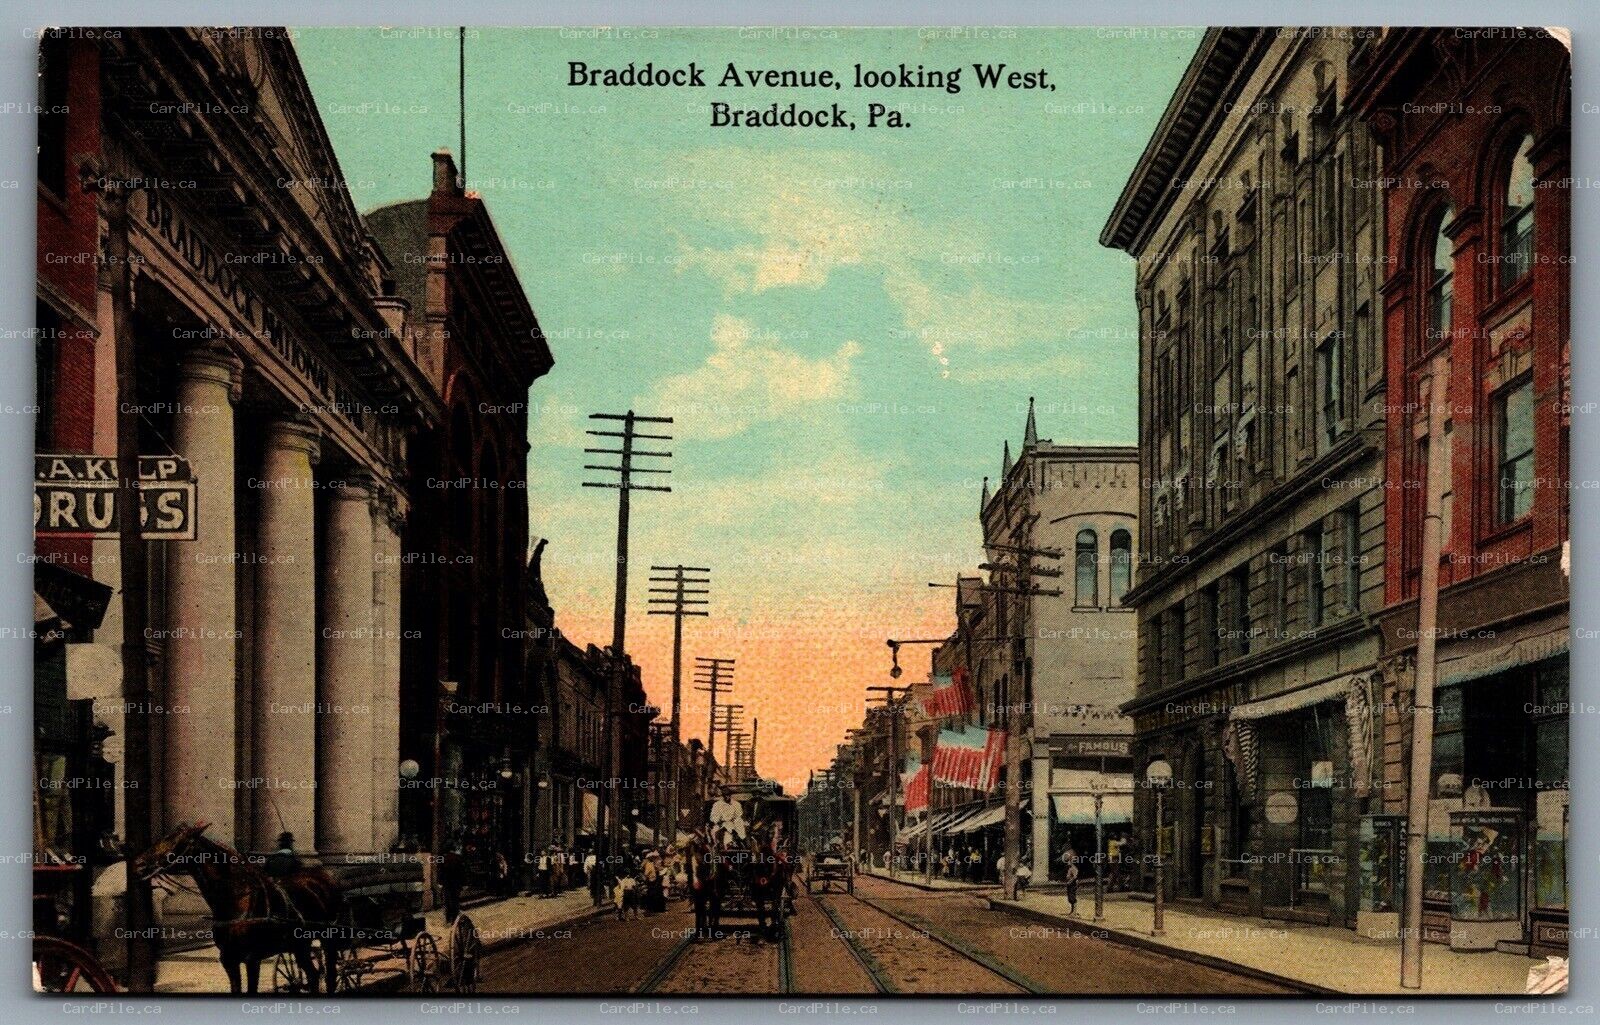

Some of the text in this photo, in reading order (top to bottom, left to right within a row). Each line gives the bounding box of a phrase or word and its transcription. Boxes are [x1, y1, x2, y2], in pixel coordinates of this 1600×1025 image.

[146, 190, 265, 334] BRADDOCK
[34, 490, 185, 530] RUS
[1078, 741, 1129, 755] FAMOUS
